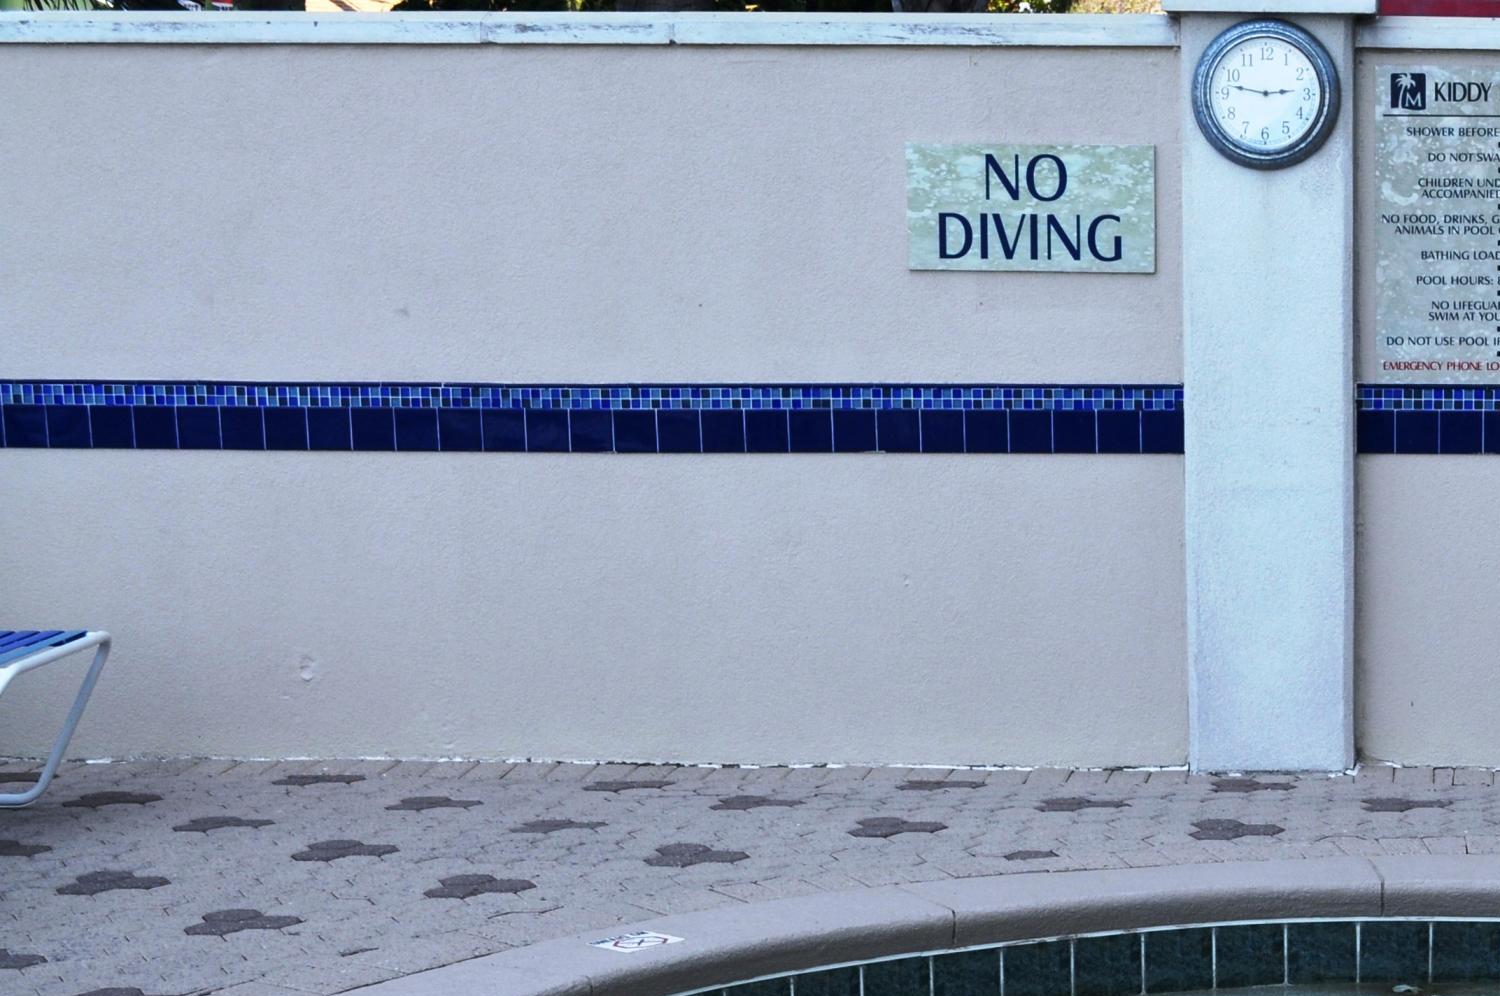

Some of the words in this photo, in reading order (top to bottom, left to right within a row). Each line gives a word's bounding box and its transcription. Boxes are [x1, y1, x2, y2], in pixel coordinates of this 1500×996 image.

[1241, 53, 1253, 67] 11
[1261, 47, 1274, 60] 12
[1284, 53, 1288, 66] 1
[1227, 69, 1240, 82] 10
[1296, 68, 1304, 81] 2
[1221, 87, 1229, 100] 9
[1303, 88, 1310, 101] 3
[1434, 82, 1492, 102] KIDDY
[1405, 91, 1422, 107] M
[1227, 107, 1235, 120] 8
[1296, 106, 1303, 119] 4
[1242, 121, 1249, 134] 7
[1261, 128, 1269, 140] 6
[1282, 121, 1290, 134] 5
[1407, 127, 1454, 136] SHOWER
[1459, 127, 1499, 137] BEFORE
[1428, 153, 1446, 162] DO
[1450, 153, 1474, 162] NOT
[985, 154, 1067, 201] NO
[1418, 178, 1473, 187] CHILDREN
[1382, 214, 1400, 224] NO
[1404, 215, 1440, 225] FOOD,
[1444, 215, 1487, 226] DRINKS,
[938, 212, 1122, 261] DIVING
[1394, 225, 1444, 234] ANIMALS
[1448, 225, 1459, 234] IN
[1464, 225, 1495, 235] POOL
[1421, 251, 1470, 260] BATHING
[1416, 276, 1447, 285] POOL
[1451, 276, 1494, 285] HOURS:
[1432, 301, 1449, 310] NO
[1429, 312, 1459, 321] SWIM
[1463, 313, 1475, 321] AT
[1386, 337, 1404, 346] DO
[1408, 337, 1432, 346] NOT
[1435, 337, 1455, 346] USE
[1459, 337, 1490, 346] POOL
[1383, 362, 1443, 371] EMERGENCY
[1447, 362, 1482, 371] PHONE
